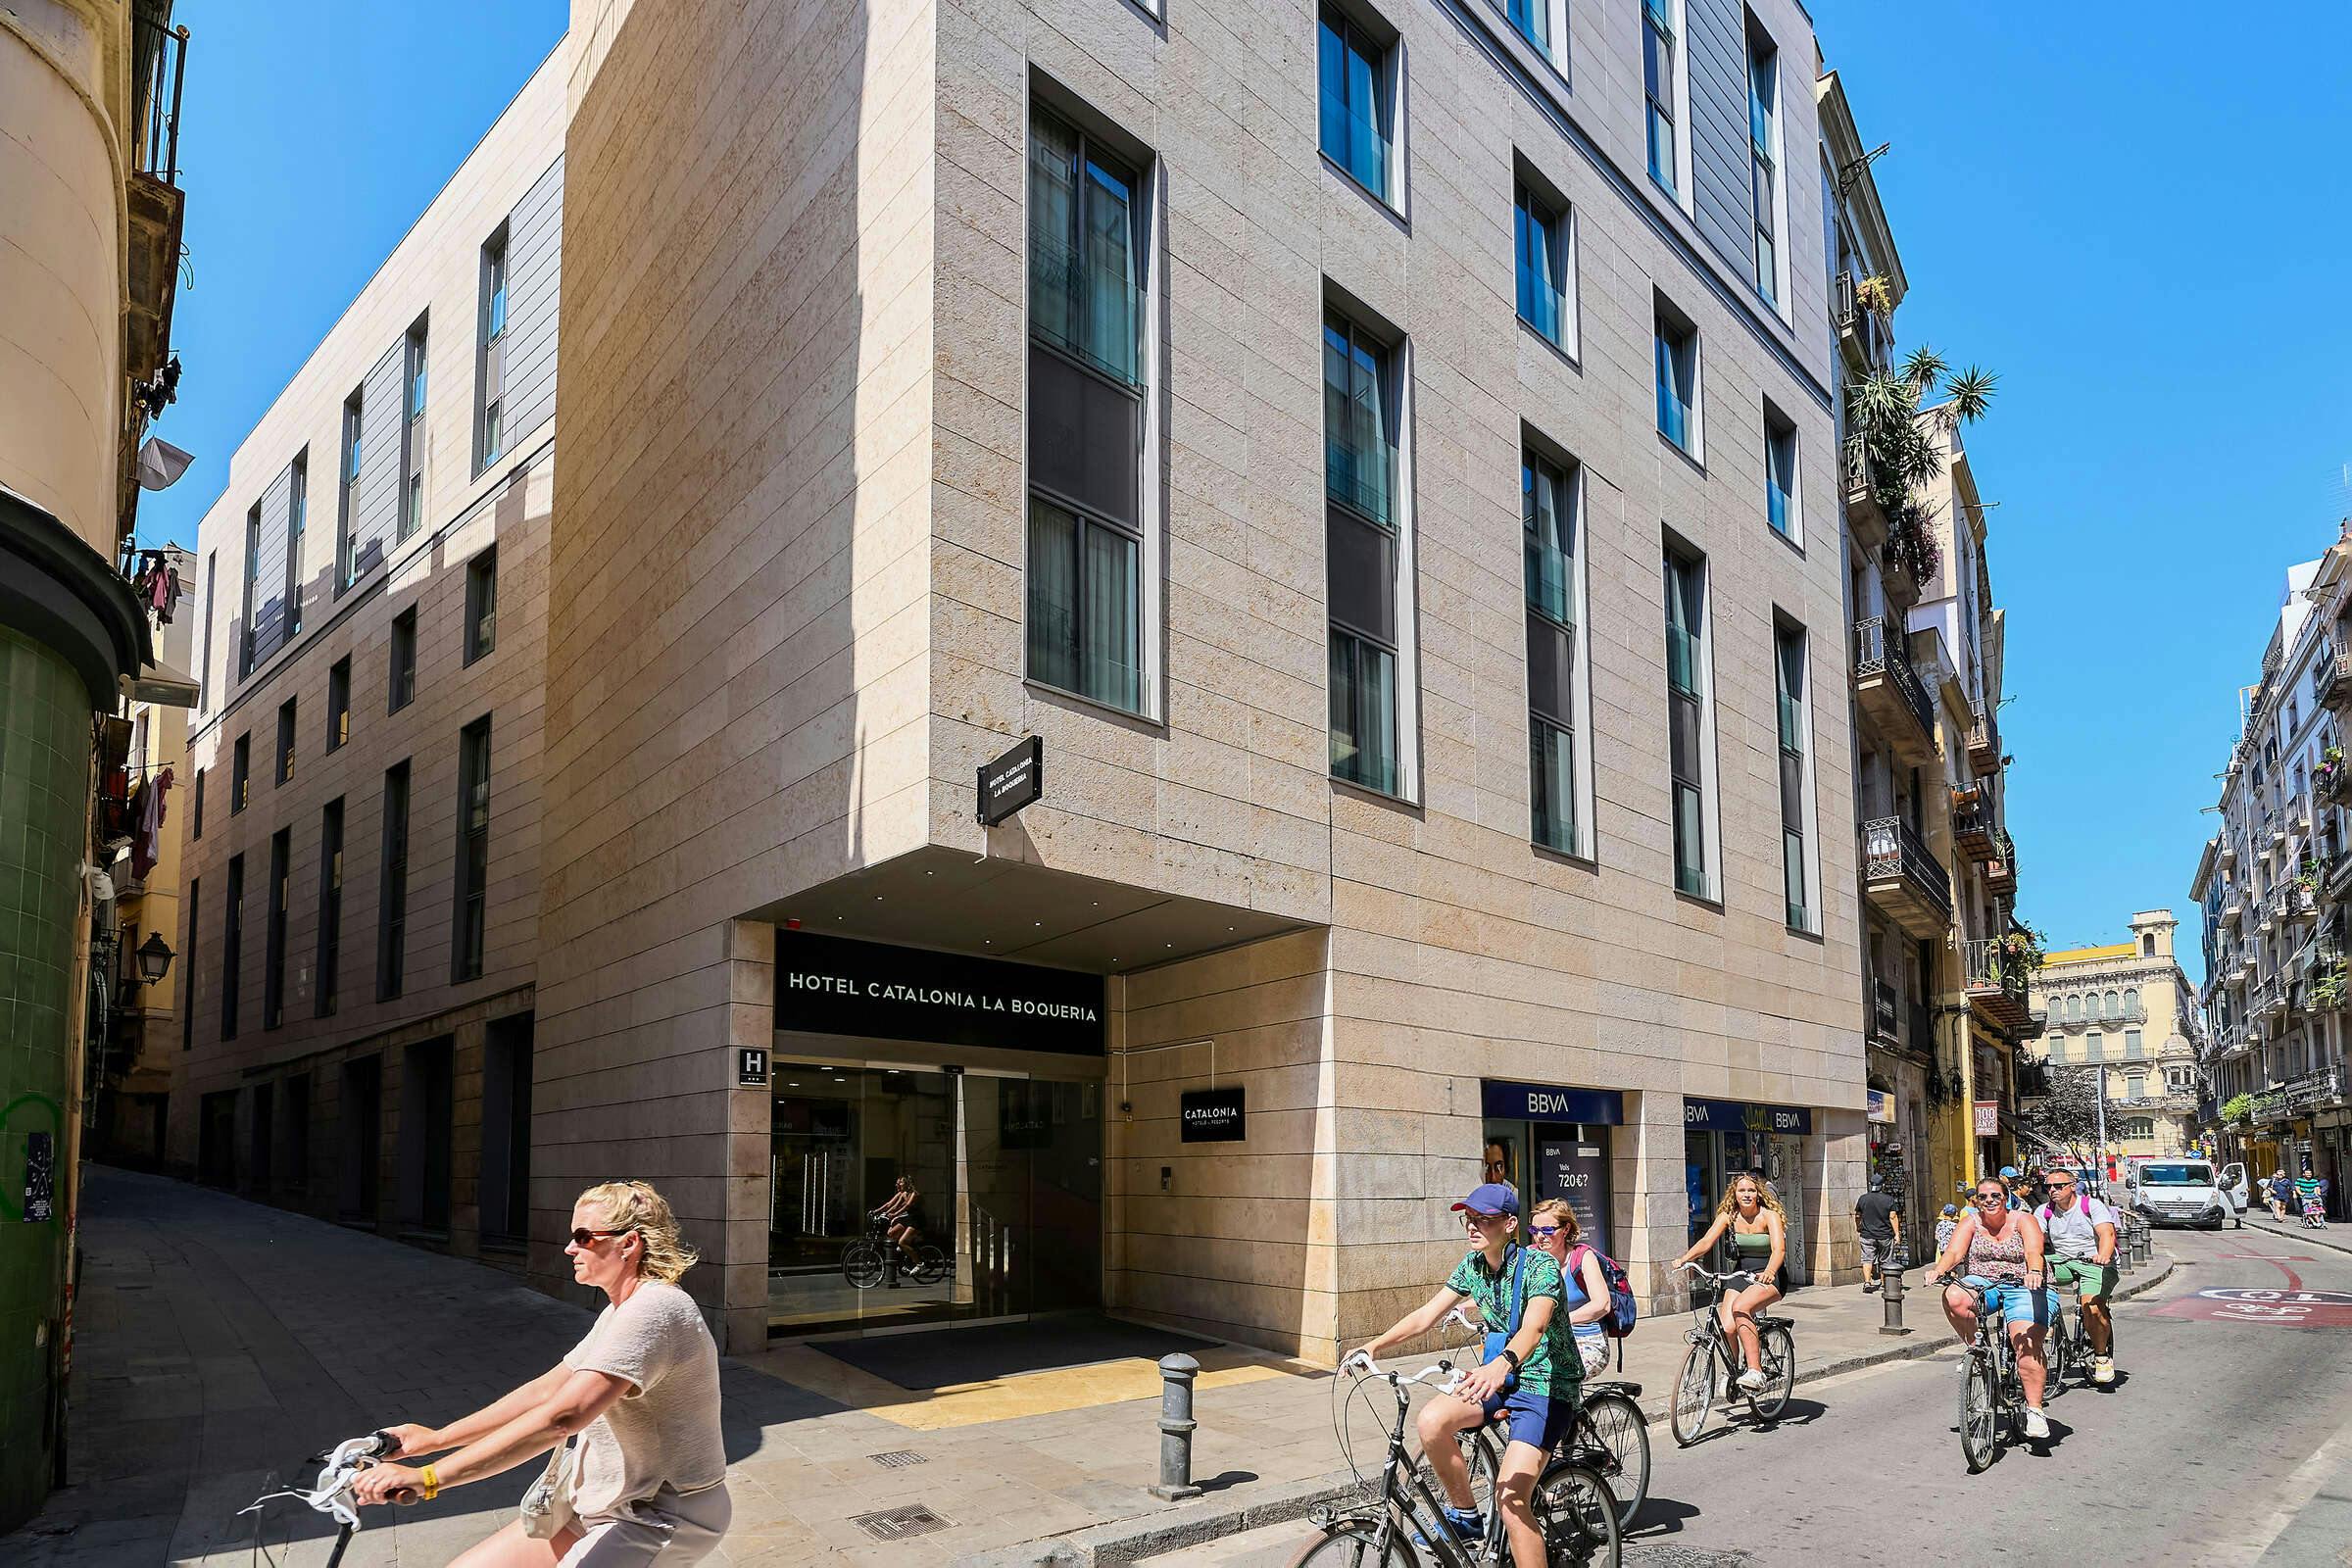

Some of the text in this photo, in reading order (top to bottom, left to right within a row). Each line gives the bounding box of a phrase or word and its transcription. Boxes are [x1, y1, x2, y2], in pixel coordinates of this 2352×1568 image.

[990, 757, 1033, 788] HOTEL CATALONIA
[994, 773, 1027, 798] LA BOQUERIA
[790, 972, 1097, 1022] HOTEL CATALONIA LA BOQUERIA
[746, 1053, 761, 1072] H
[1528, 1093, 1569, 1113] BBVA
[1185, 1107, 1237, 1119] CATALONIA
[1776, 1112, 1800, 1128] BBVA
[1976, 1108, 1995, 1120] 100
[1545, 1148, 1561, 1156] BBVA
